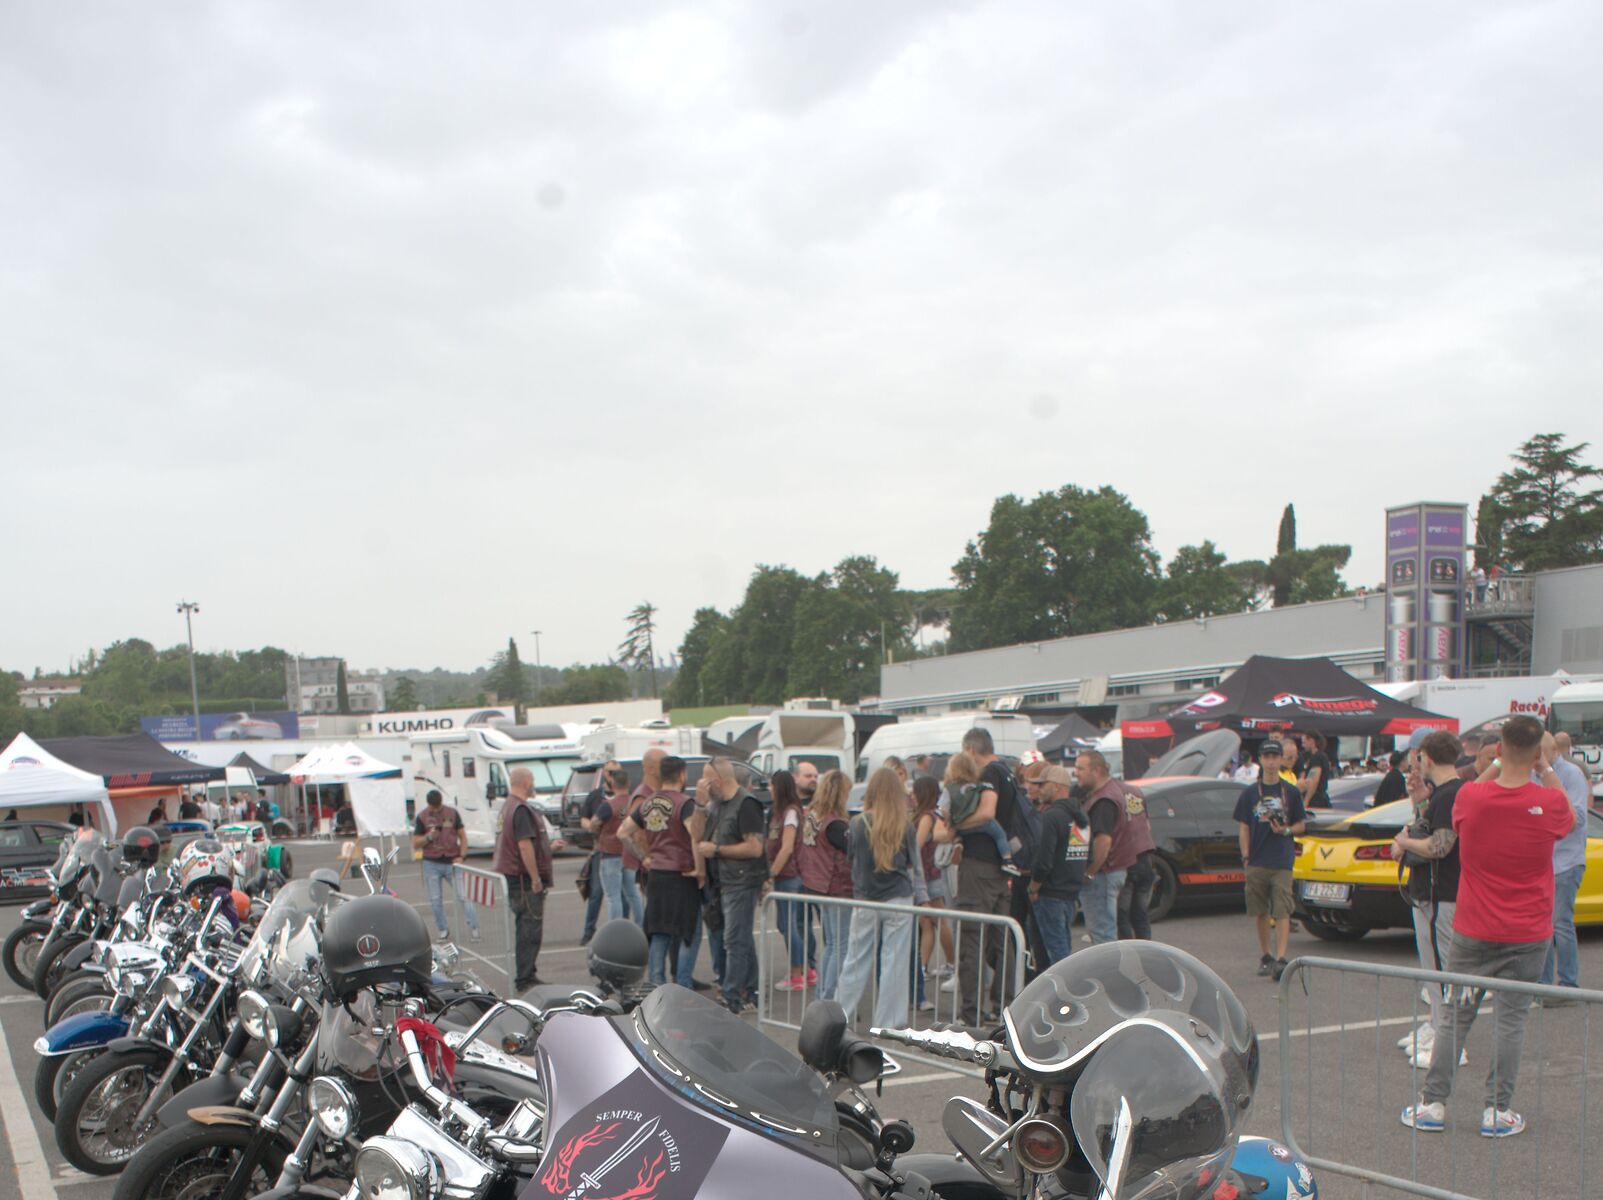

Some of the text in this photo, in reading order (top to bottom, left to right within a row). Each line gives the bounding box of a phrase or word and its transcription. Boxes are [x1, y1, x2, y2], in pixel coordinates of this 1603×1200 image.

[379, 718, 453, 733] KUMHO
[1217, 873, 1245, 881] MUS
[596, 1110, 643, 1122] SEMPER
[658, 1129, 681, 1173] FIDELIS
